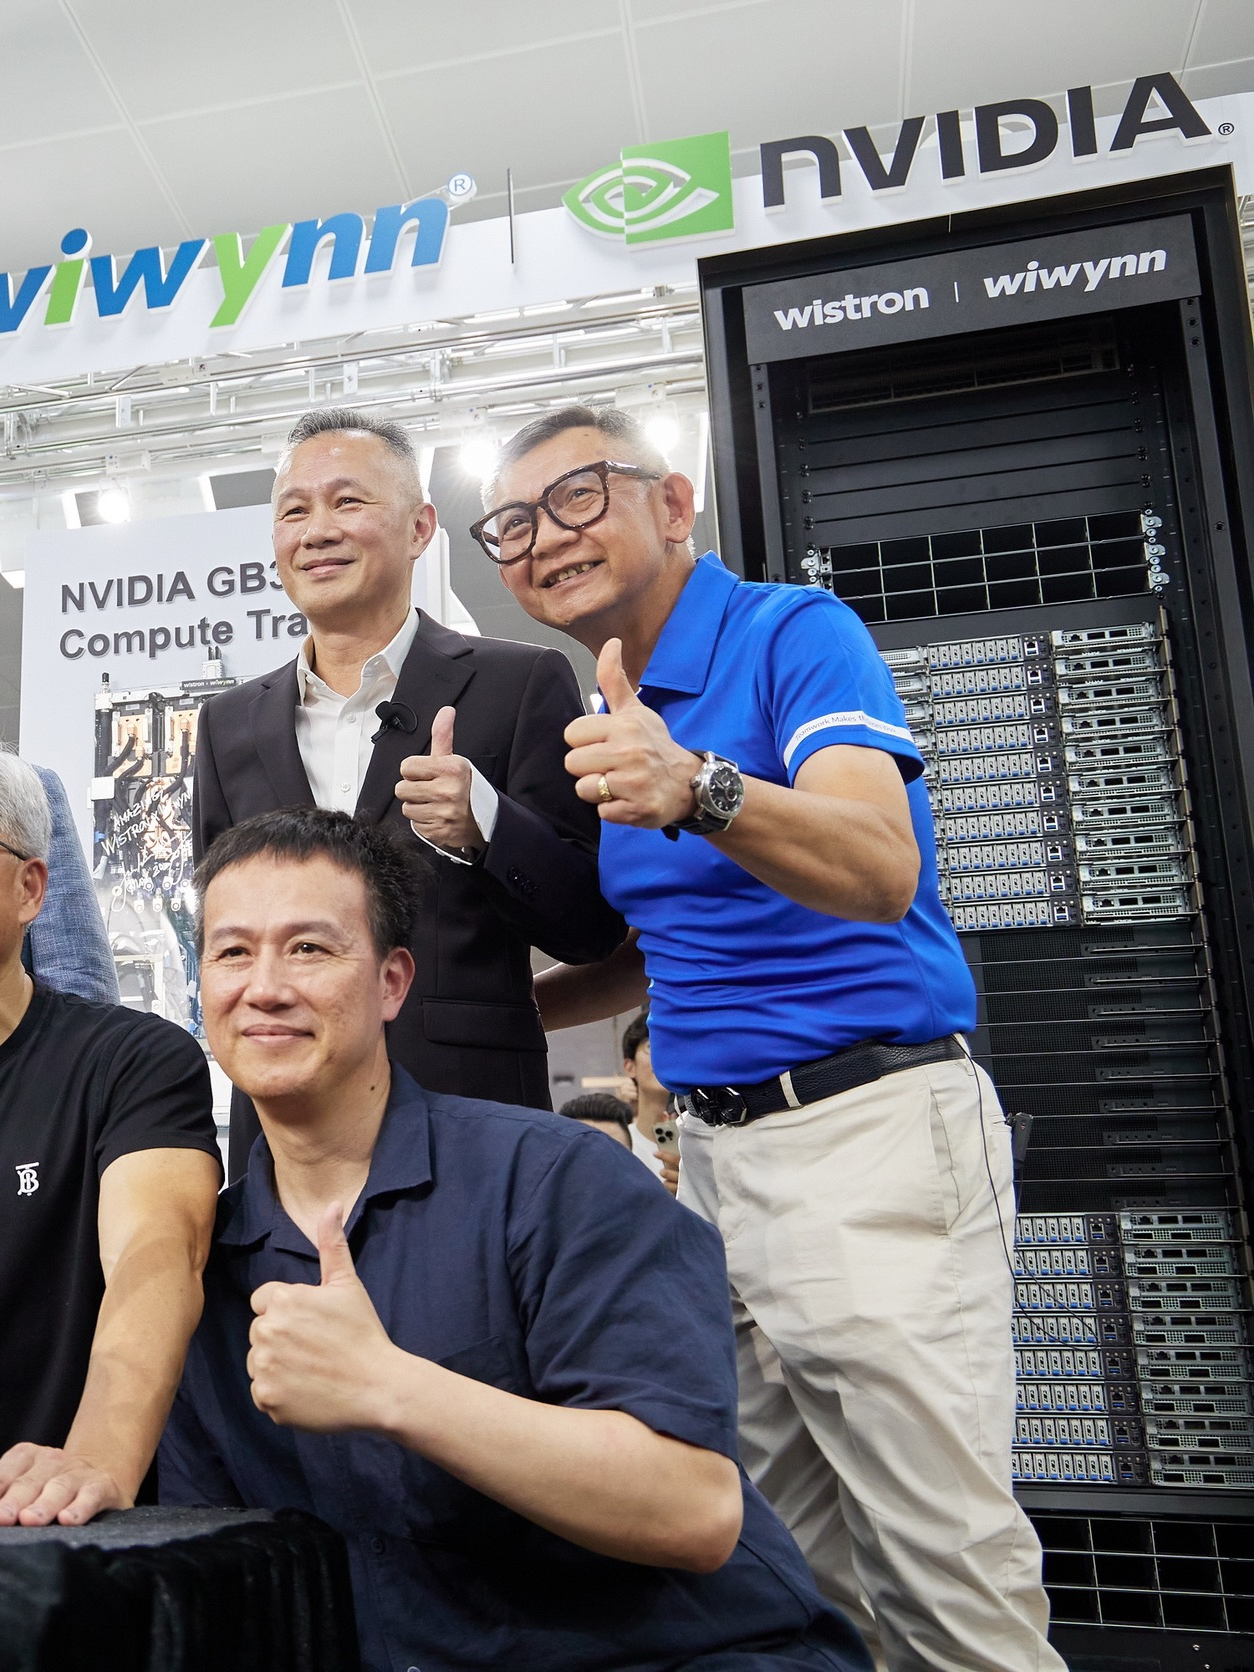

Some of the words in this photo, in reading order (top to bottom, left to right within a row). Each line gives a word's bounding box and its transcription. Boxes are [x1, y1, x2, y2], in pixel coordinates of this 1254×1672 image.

[773, 286, 930, 331] wistron
[983, 248, 1167, 292] wiwynn
[60, 571, 196, 614] NVIDIA
[59, 616, 234, 660] Compute
[246, 608, 309, 640] Tra
[831, 715, 856, 723] Makes
